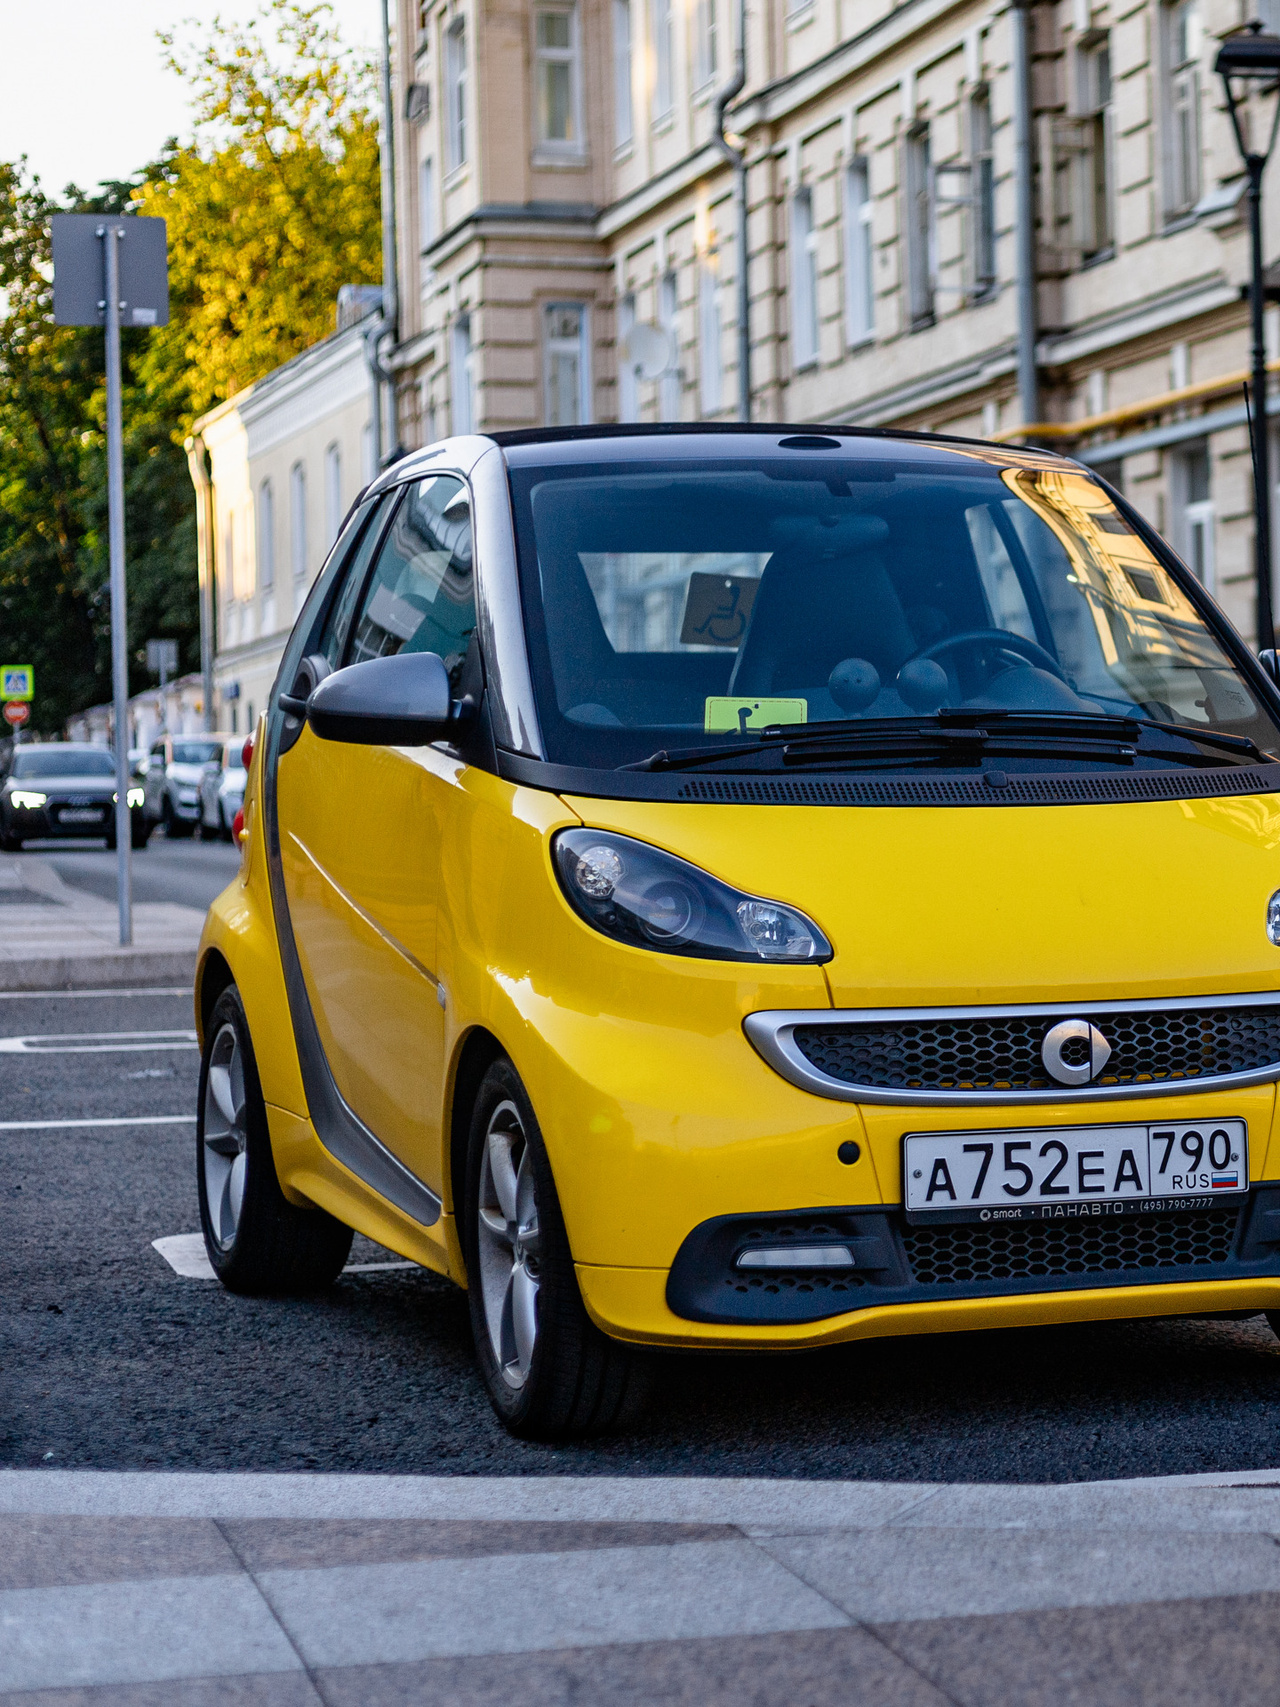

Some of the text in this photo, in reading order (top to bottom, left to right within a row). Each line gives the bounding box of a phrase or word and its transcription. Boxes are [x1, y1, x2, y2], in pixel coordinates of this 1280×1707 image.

[1152, 1128, 1232, 1174] 790
[1172, 1173, 1210, 1190] RUS
[993, 1198, 1214, 1219] smart ПАНАВТО (495) 790-7777
